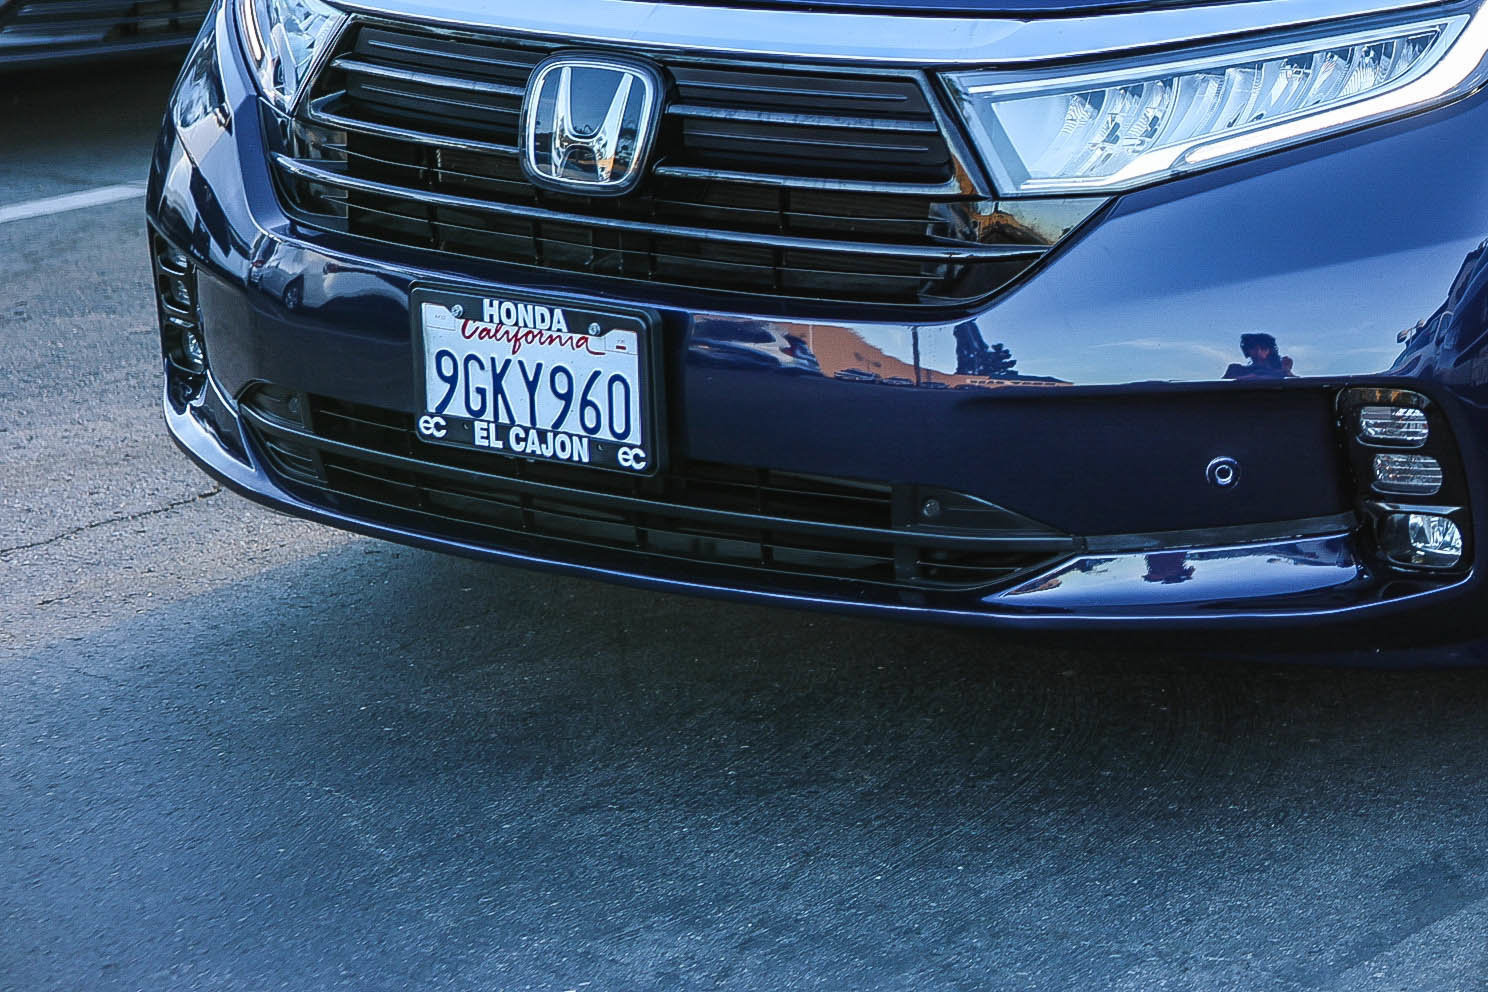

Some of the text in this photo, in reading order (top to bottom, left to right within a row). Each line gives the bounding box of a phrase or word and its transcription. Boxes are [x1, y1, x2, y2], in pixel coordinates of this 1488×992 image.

[482, 298, 569, 333] HONDA
[461, 318, 607, 356] California
[434, 348, 632, 442] 9GKY960
[474, 420, 590, 463] EL CAJON
